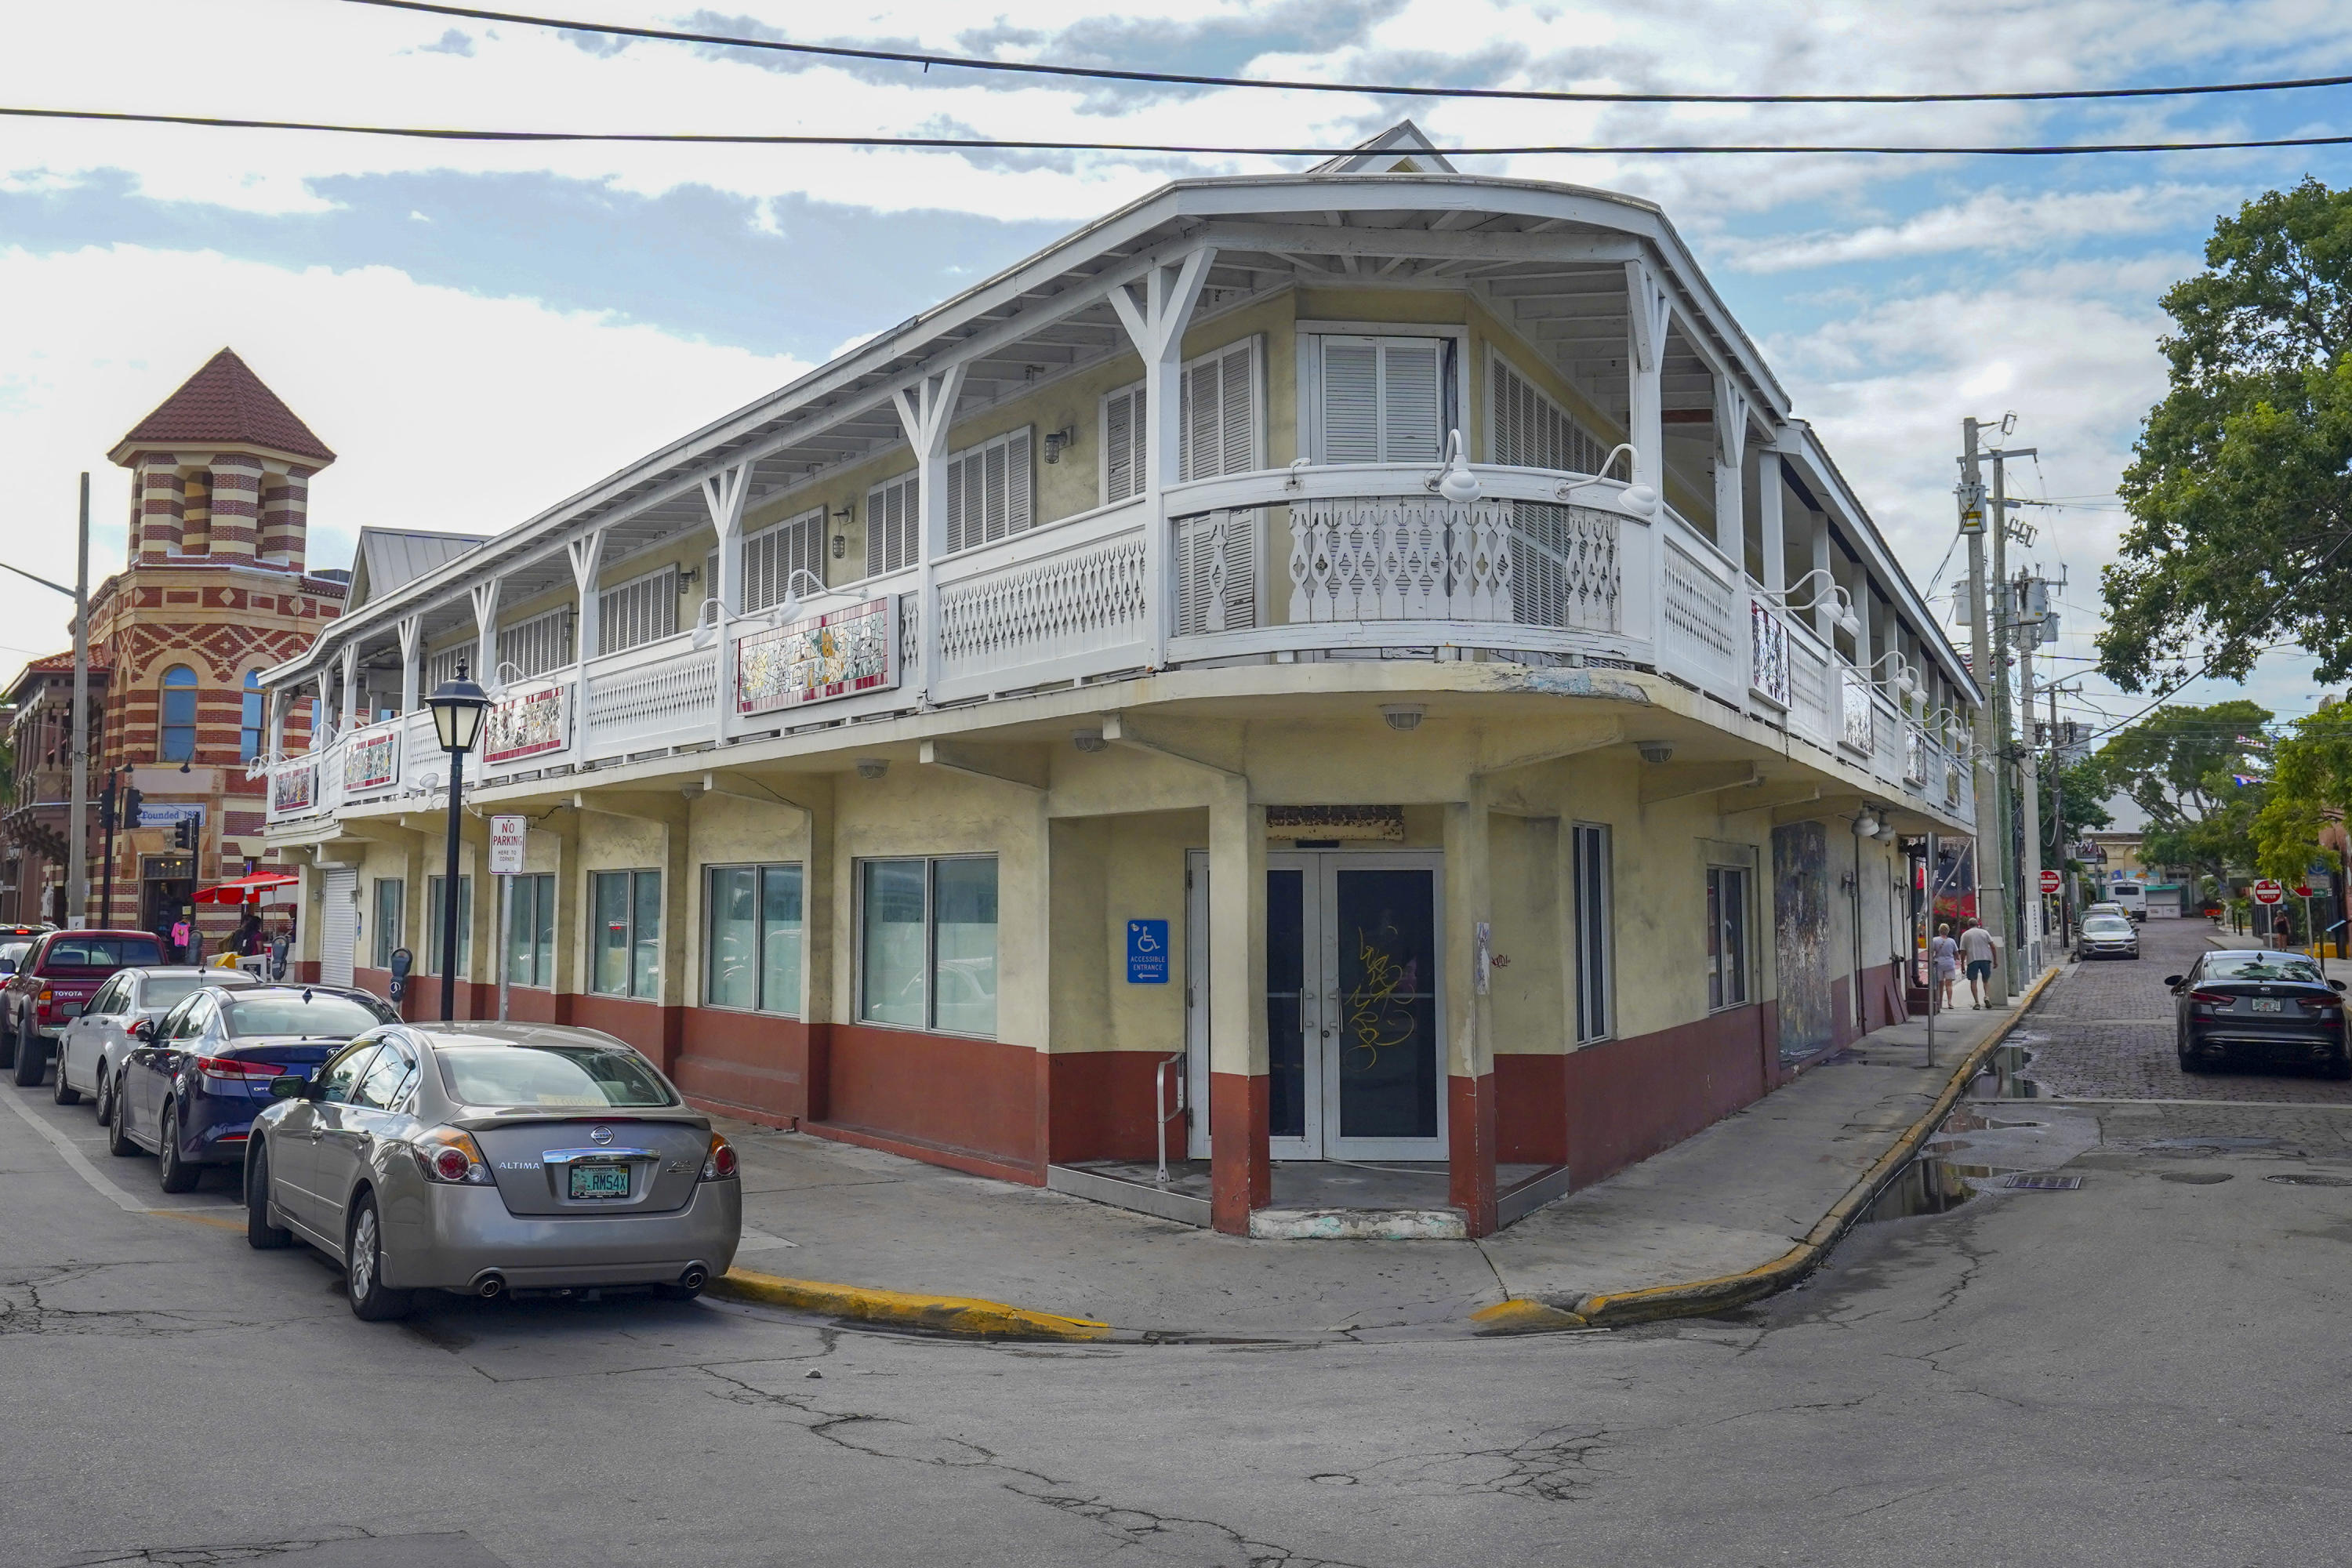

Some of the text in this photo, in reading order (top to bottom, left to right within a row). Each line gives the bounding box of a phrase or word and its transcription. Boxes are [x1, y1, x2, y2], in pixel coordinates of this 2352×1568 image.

[142, 811, 180, 819] Founded
[502, 822, 515, 833] NO
[493, 836, 523, 846] PARKING
[499, 1161, 540, 1170] ALTIMA
[593, 1174, 626, 1190] RMS4X
